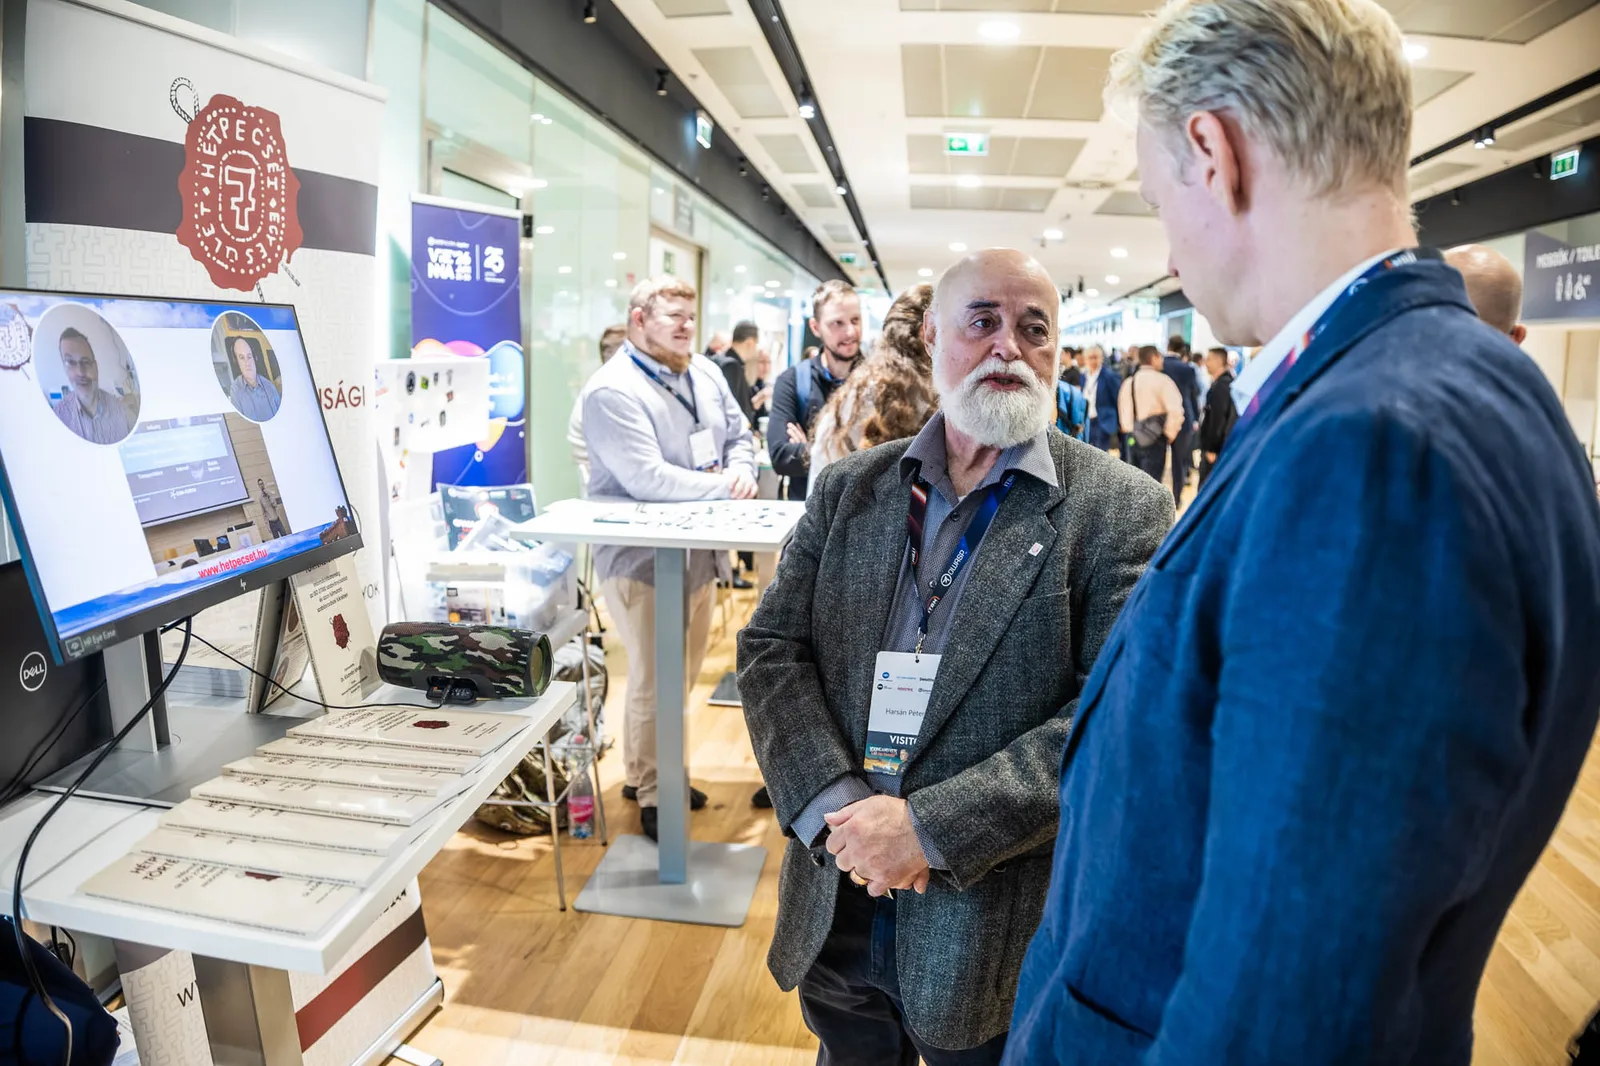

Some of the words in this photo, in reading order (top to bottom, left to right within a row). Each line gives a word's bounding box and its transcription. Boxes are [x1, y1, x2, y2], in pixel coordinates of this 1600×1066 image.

[319, 380, 366, 410] SÁGI
[198, 548, 268, 579] www.hetpecset.hu
[23, 663, 45, 681] DELL
